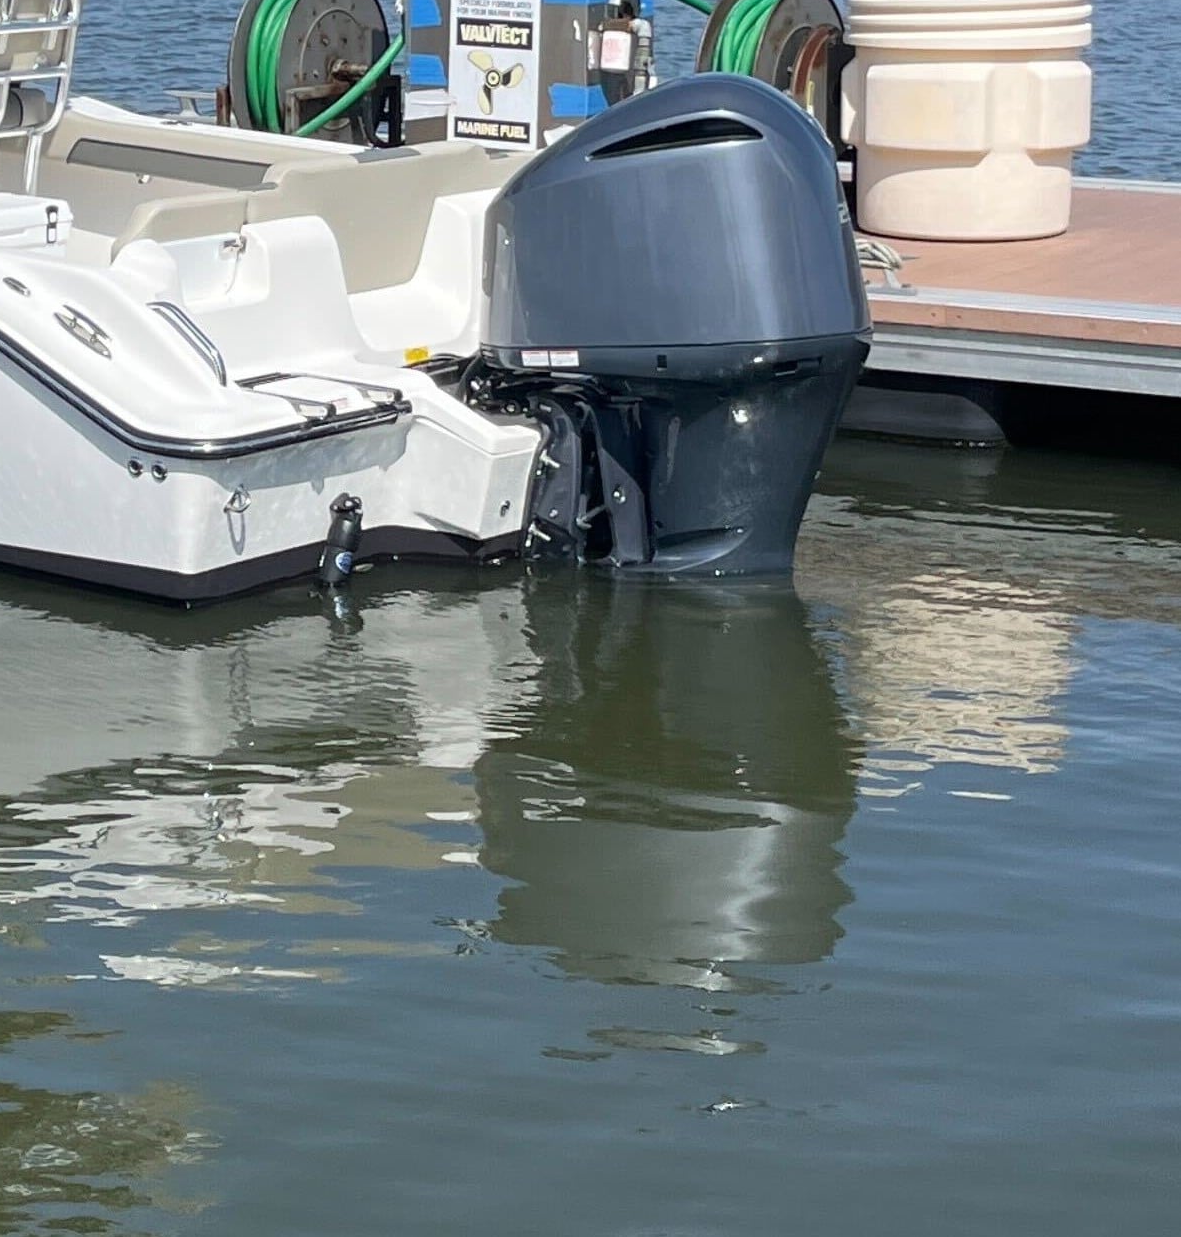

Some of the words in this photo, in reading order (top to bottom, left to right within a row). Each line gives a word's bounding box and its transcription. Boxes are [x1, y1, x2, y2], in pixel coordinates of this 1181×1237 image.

[460, 22, 531, 46] VALVTECT
[457, 120, 499, 137] MARINE
[499, 124, 528, 140] FUEL
